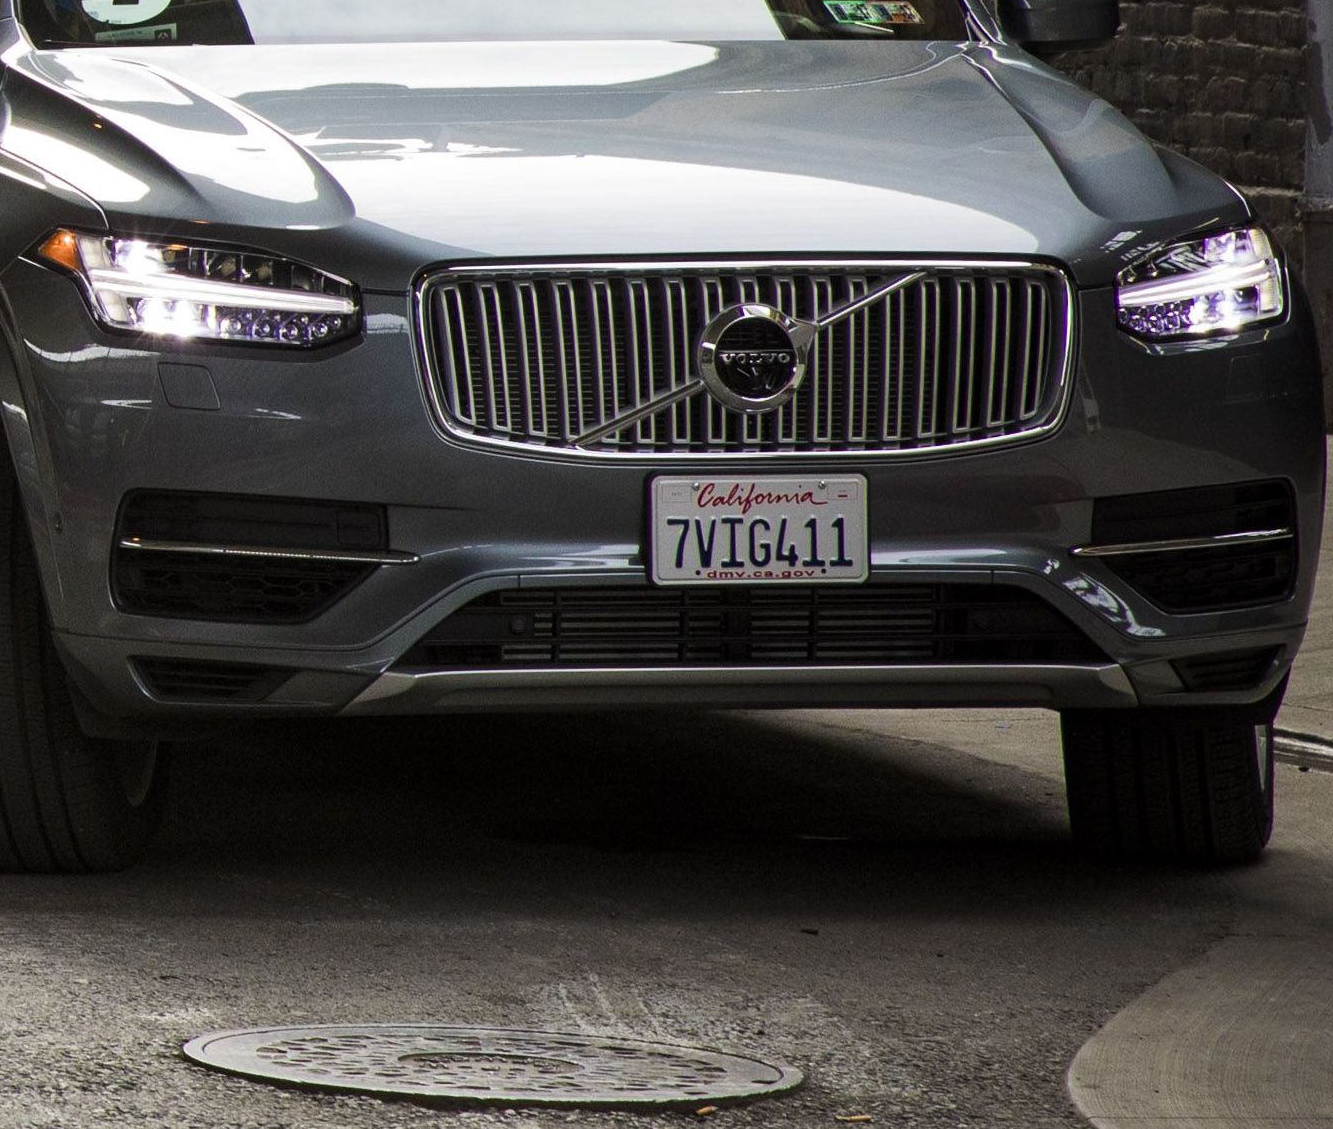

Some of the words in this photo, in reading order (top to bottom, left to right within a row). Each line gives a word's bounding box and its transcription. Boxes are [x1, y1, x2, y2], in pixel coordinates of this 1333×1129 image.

[719, 353, 791, 364] VOLVO
[697, 483, 828, 514] California
[666, 516, 854, 569] 7VIG411
[707, 569, 815, 580] dmv.ca.gov
